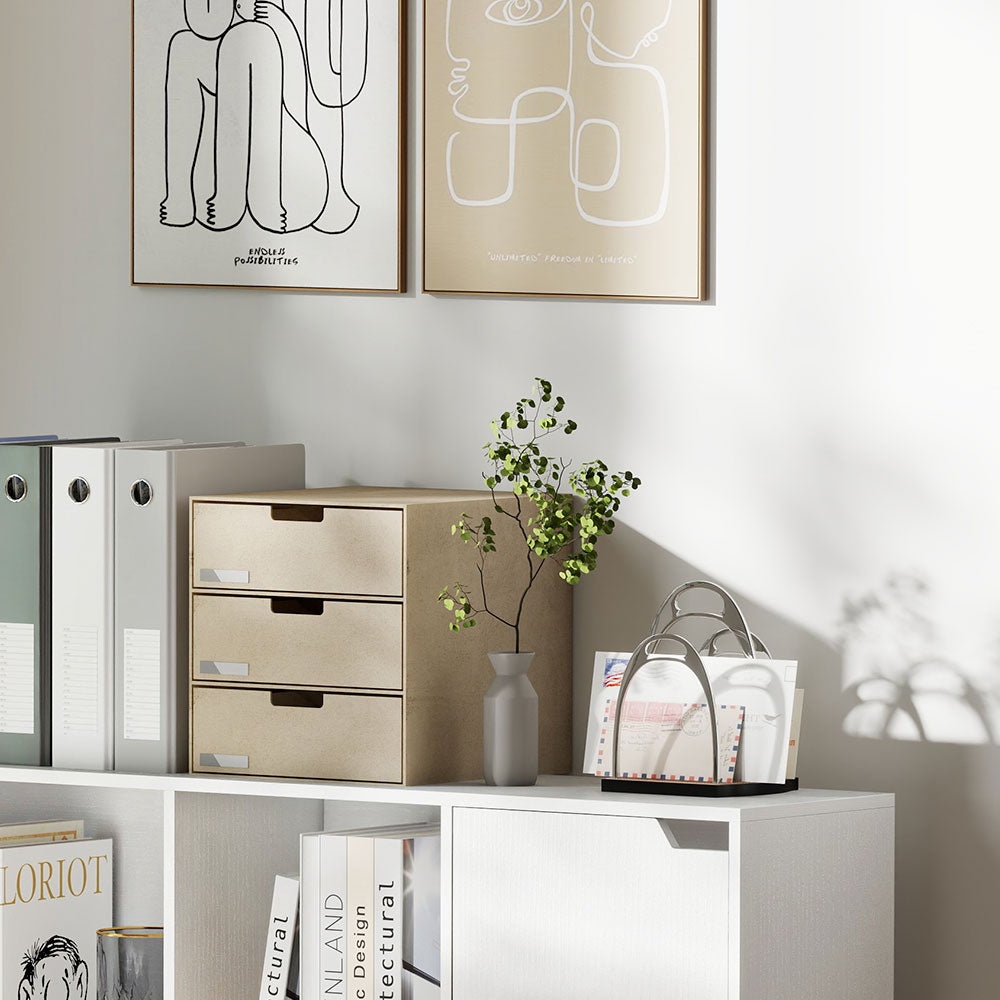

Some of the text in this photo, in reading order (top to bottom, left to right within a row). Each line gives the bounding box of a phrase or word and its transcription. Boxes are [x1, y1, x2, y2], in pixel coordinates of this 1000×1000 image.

[233, 255, 299, 267] POSSIBILITIES
[248, 247, 286, 256] ENDLESS
[0, 854, 108, 906] LORIOT
[354, 905, 368, 978] Design
